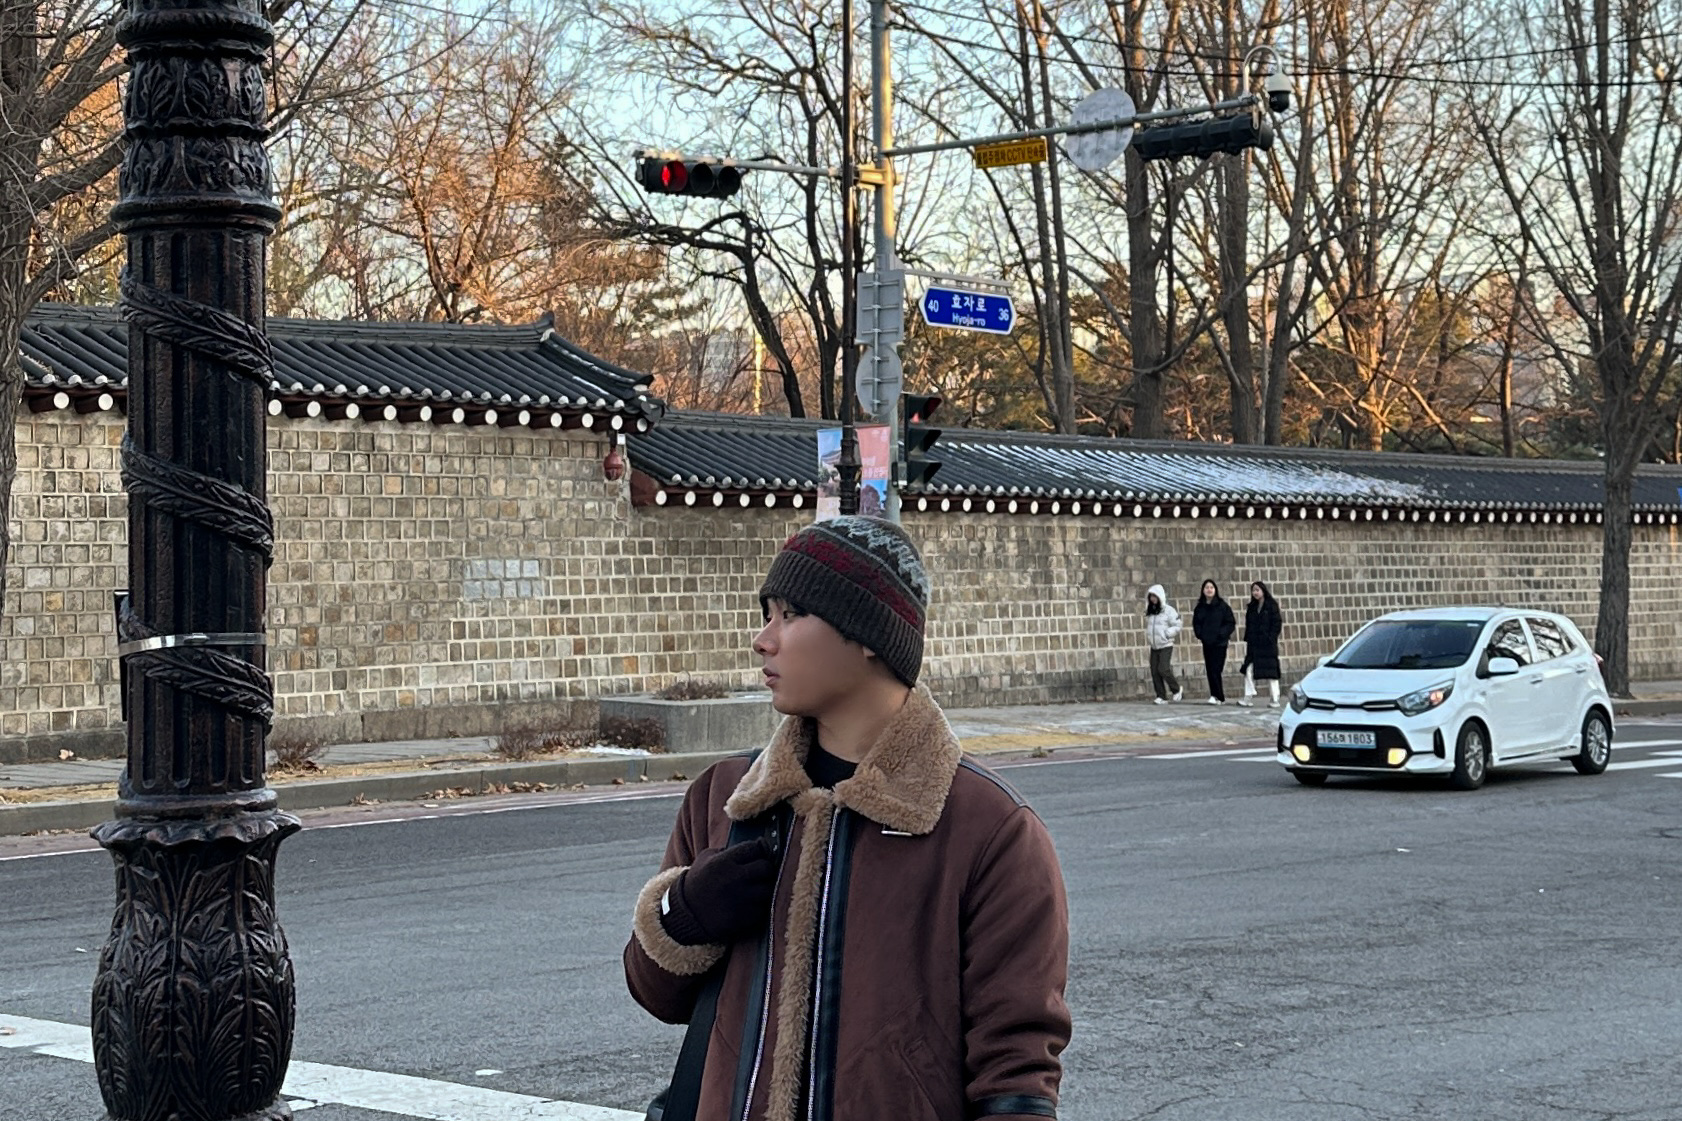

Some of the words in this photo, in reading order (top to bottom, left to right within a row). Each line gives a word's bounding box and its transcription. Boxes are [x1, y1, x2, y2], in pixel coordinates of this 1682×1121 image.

[1007, 147, 1026, 162] CCTV
[927, 299, 939, 313] 40
[951, 294, 987, 312] 효자로
[952, 312, 986, 327] Hyoja-ro
[998, 308, 1010, 321] 36
